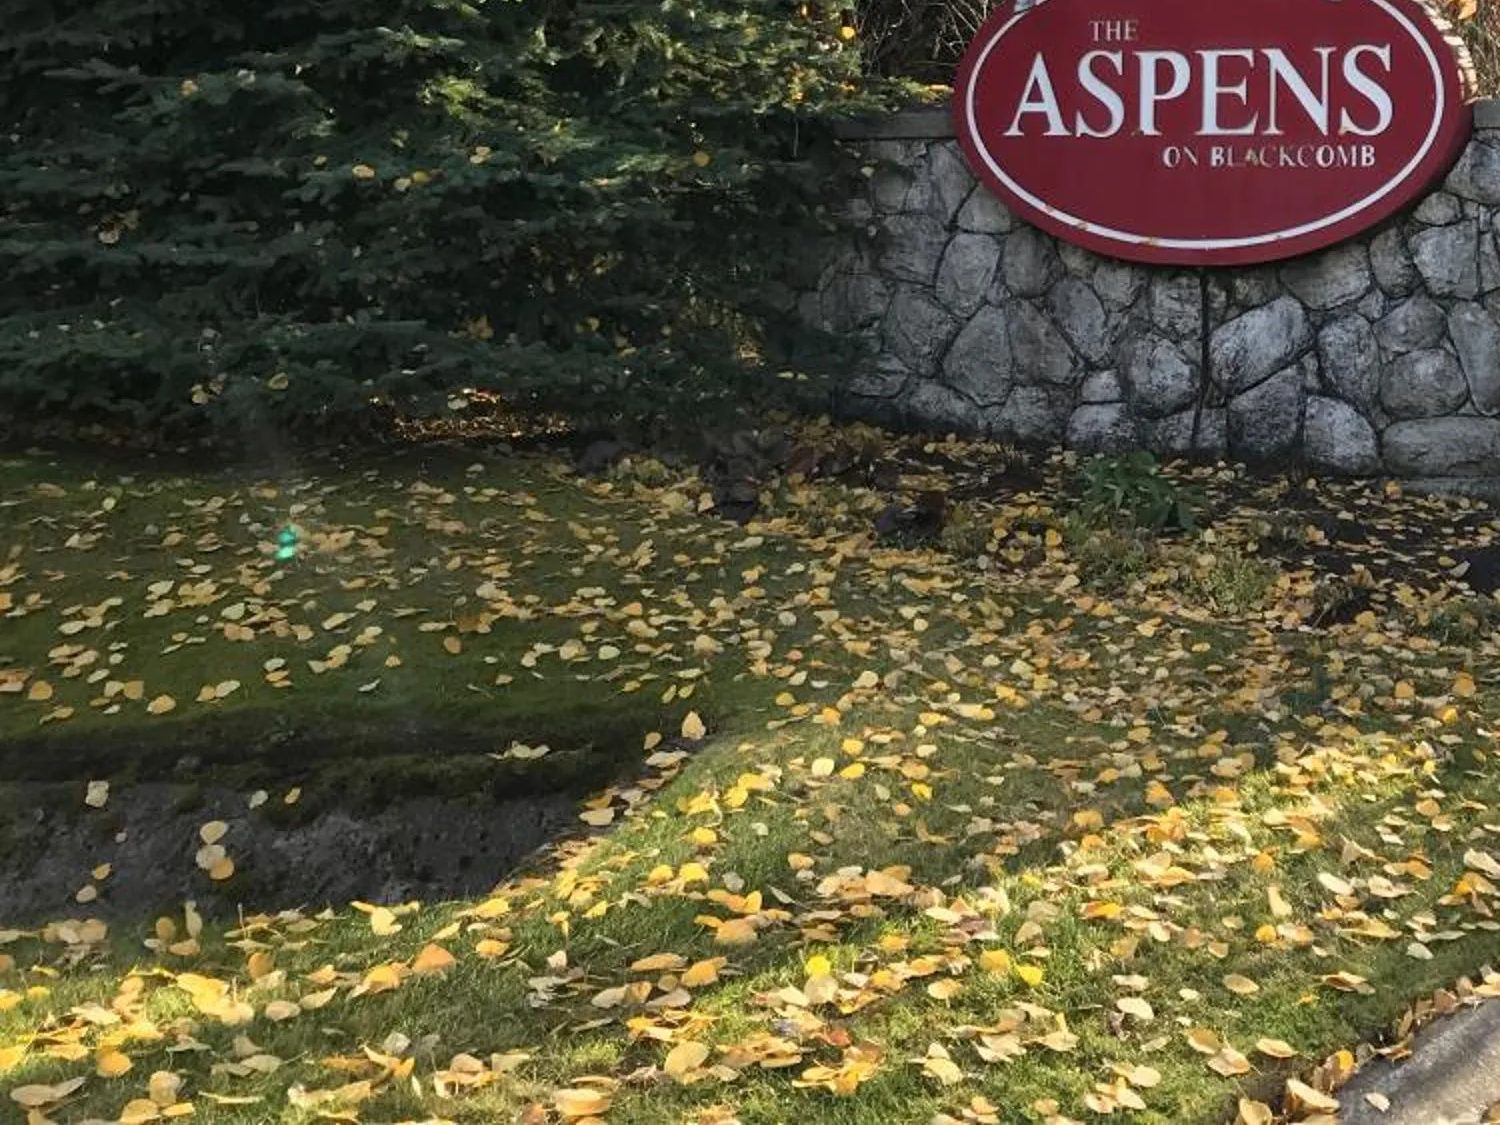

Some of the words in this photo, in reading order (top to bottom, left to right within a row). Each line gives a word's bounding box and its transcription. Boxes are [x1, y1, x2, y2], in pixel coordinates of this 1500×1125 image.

[1089, 19, 1139, 42] THE
[1002, 43, 1394, 139] ASPENS
[1162, 145, 1199, 168] ON
[1210, 144, 1376, 168] BLACKCOMB
